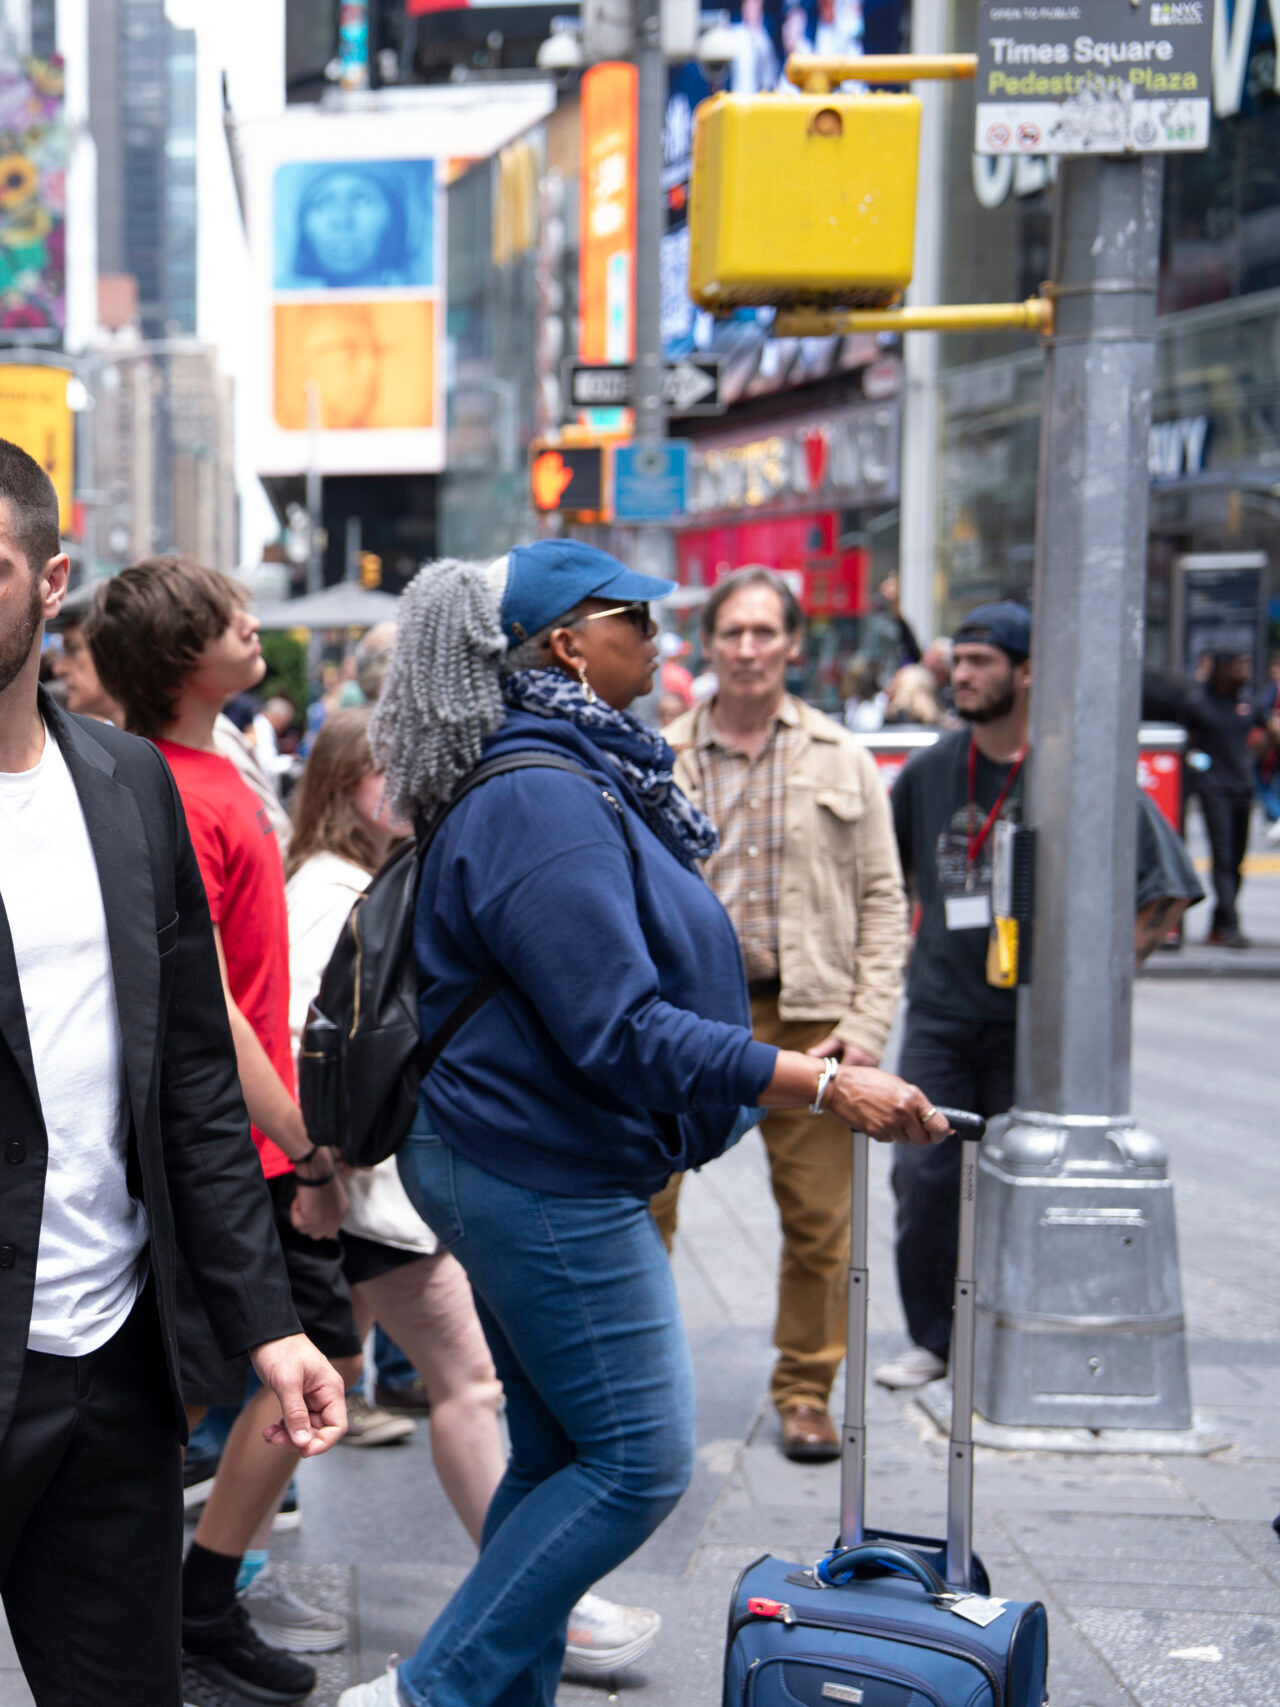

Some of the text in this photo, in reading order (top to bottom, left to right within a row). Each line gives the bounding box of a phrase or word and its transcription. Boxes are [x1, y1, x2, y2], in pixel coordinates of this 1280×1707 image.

[989, 6, 1081, 21] OPEN TO PUBLIC
[989, 36, 1174, 67] Times Square
[1128, 67, 1198, 91] Plaza
